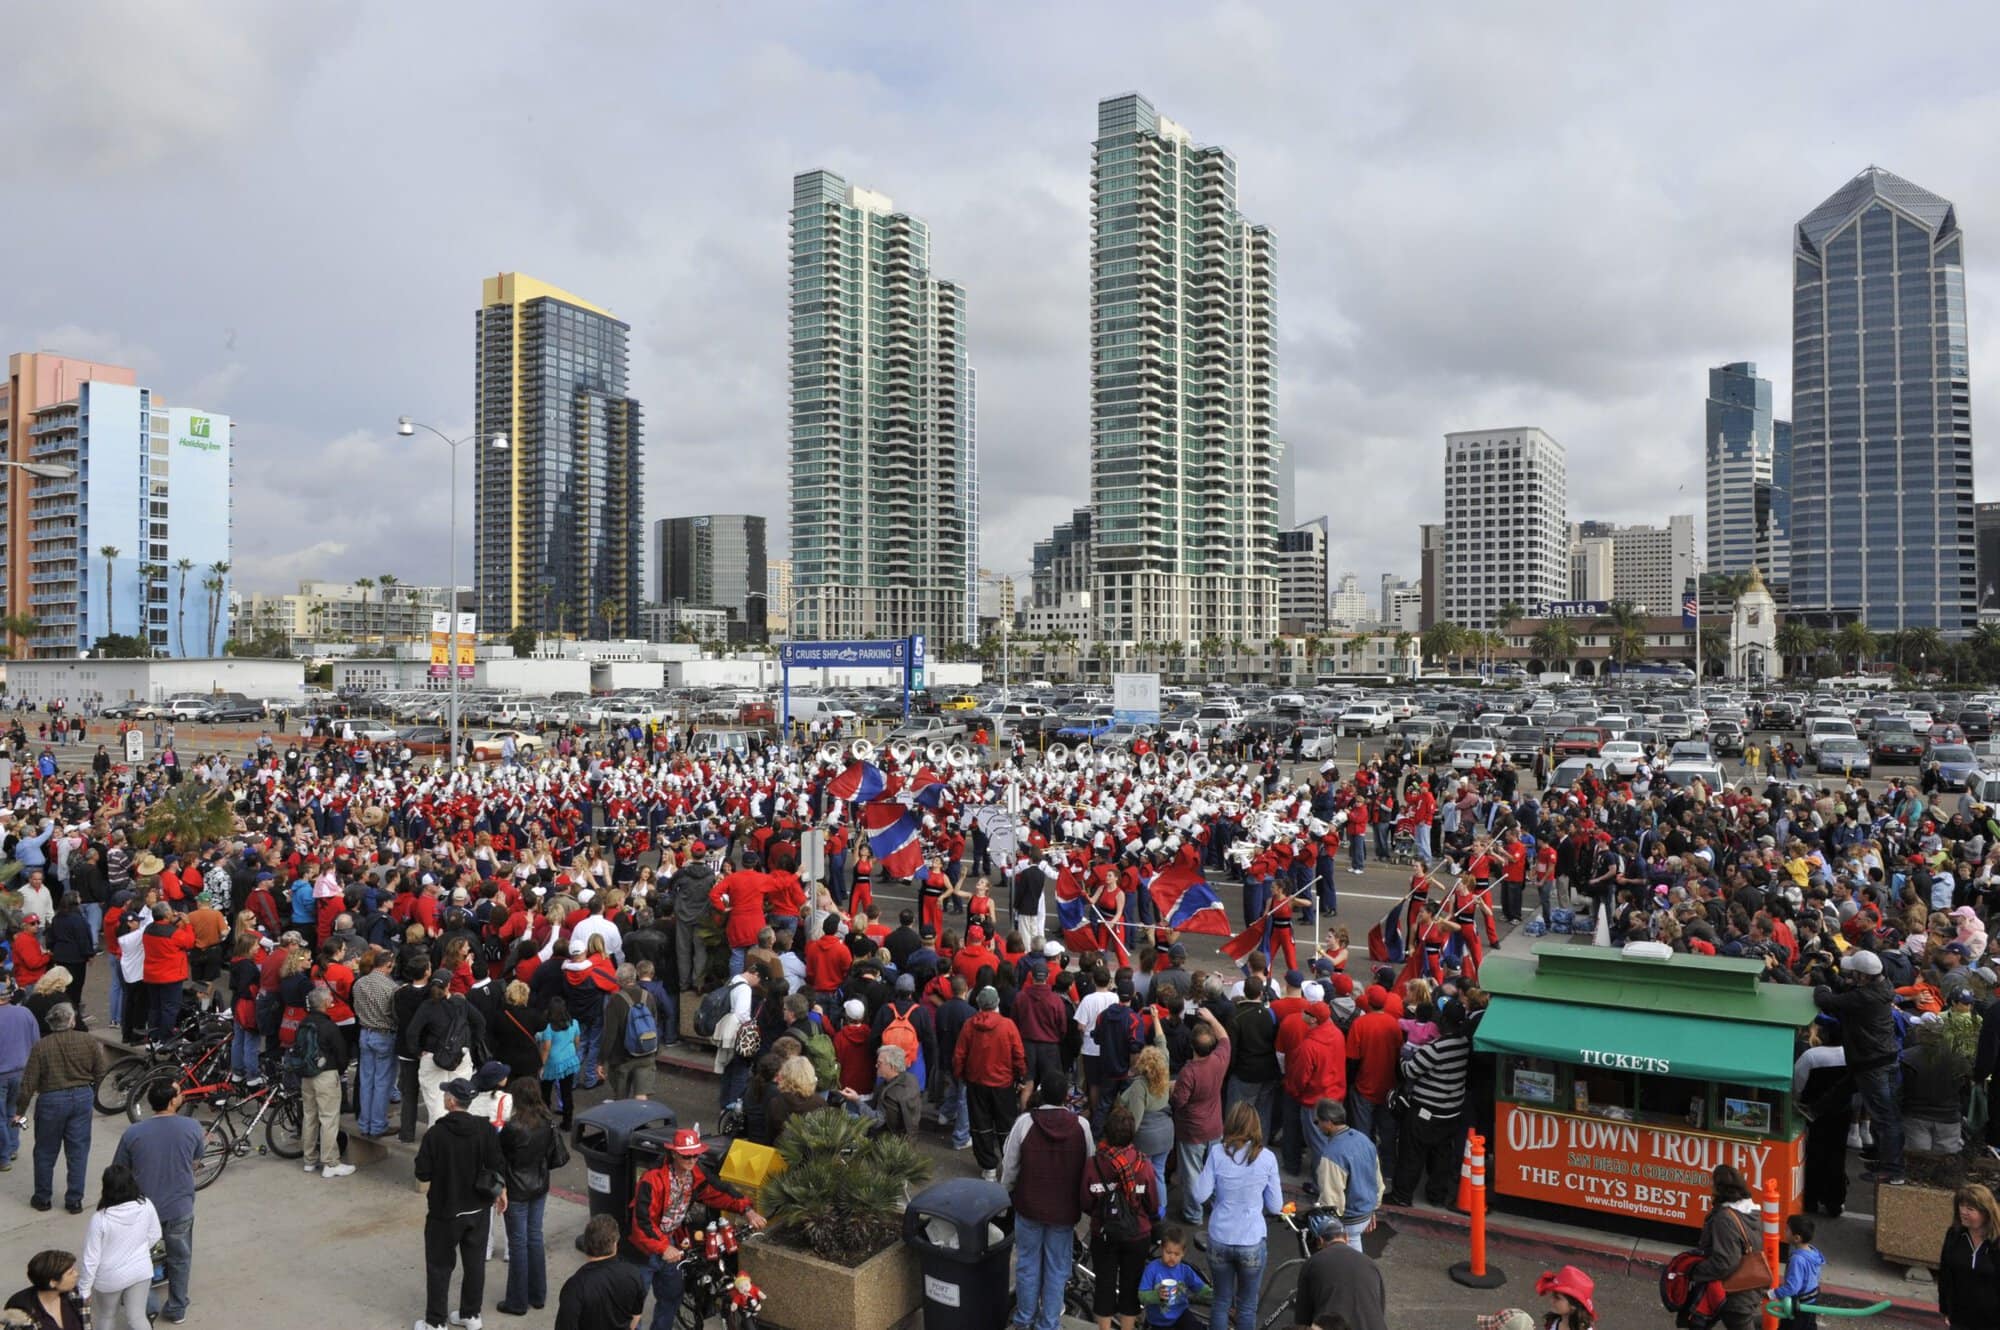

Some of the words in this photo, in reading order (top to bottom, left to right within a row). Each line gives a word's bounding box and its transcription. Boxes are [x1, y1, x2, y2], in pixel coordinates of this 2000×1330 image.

[179, 437, 208, 450] Holiday
[1540, 602, 1597, 615] Santa
[786, 646, 792, 657] 5
[795, 649, 821, 659] CRUISE
[822, 649, 838, 659] SHIP
[858, 649, 891, 659] PARKING
[895, 645, 902, 657] 5
[915, 637, 923, 657] 5
[914, 672, 922, 687] P
[1580, 1049, 1670, 1073] TICKETS
[685, 1135, 694, 1146] N
[1507, 1109, 1559, 1152] OLD
[1564, 1118, 1639, 1154] TOWN
[1648, 1130, 1773, 1191] TROLLEY
[1594, 1156, 1629, 1175] DIEGO
[1631, 1162, 1640, 1177] &
[1642, 1164, 1710, 1187] CORONADO
[1518, 1165, 1560, 1187] THE
[1564, 1173, 1627, 1198] CITY'S
[1634, 1184, 1691, 1209] BEST
[1584, 1194, 1686, 1220] www.trolleytours.com
